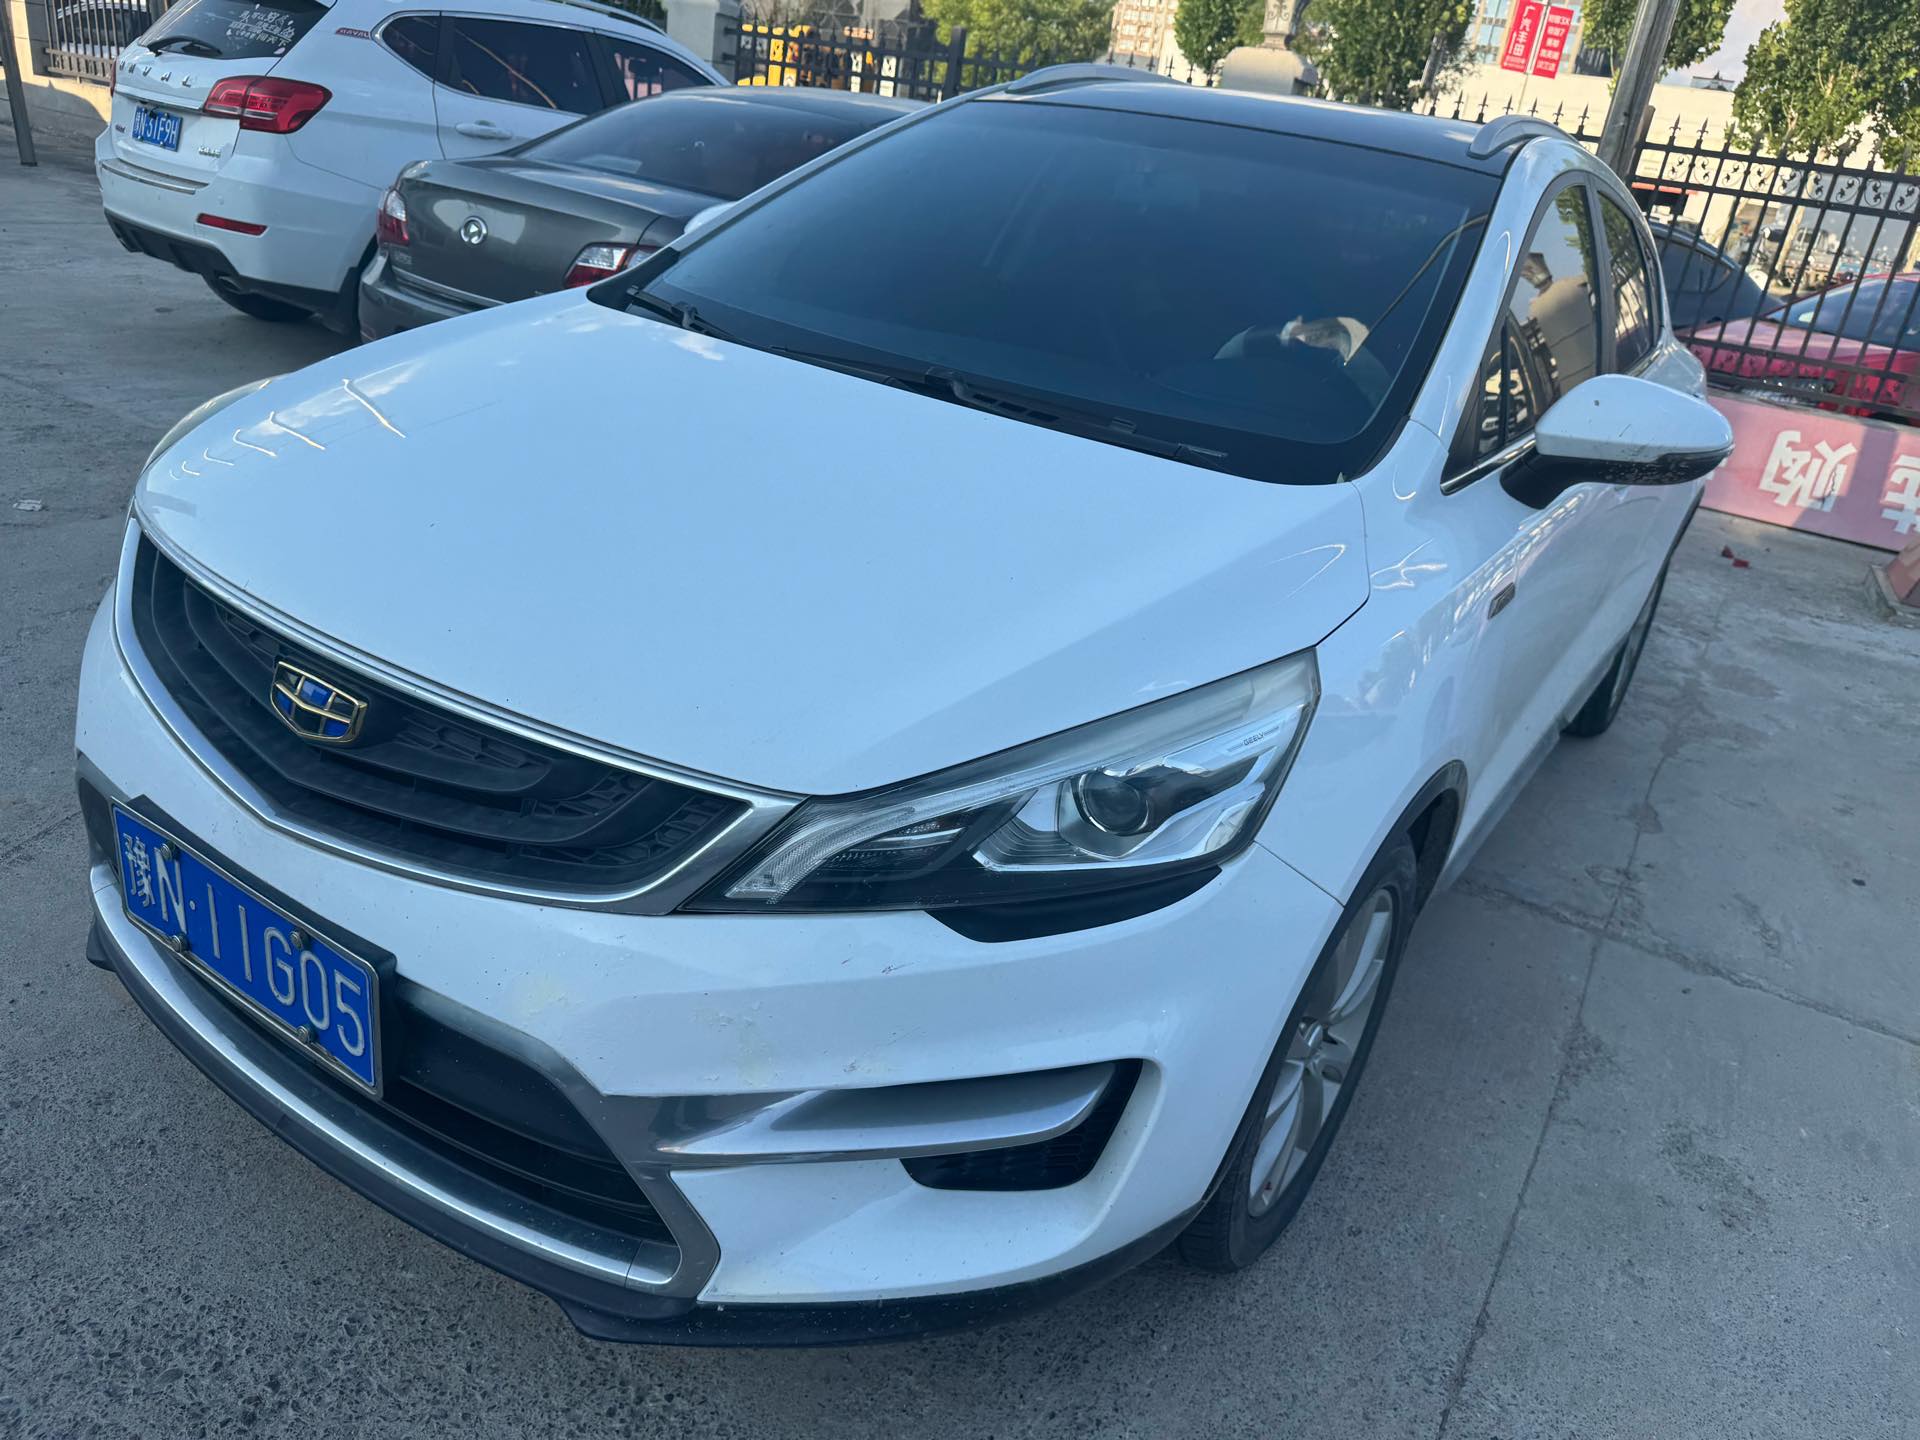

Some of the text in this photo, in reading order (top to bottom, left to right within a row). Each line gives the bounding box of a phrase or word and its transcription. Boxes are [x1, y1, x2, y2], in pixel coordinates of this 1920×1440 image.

[1513, 5, 1536, 56] 广汽丰田
[1243, 731, 1264, 746] GEELY
[123, 833, 364, 1056] 豫N·11G05
